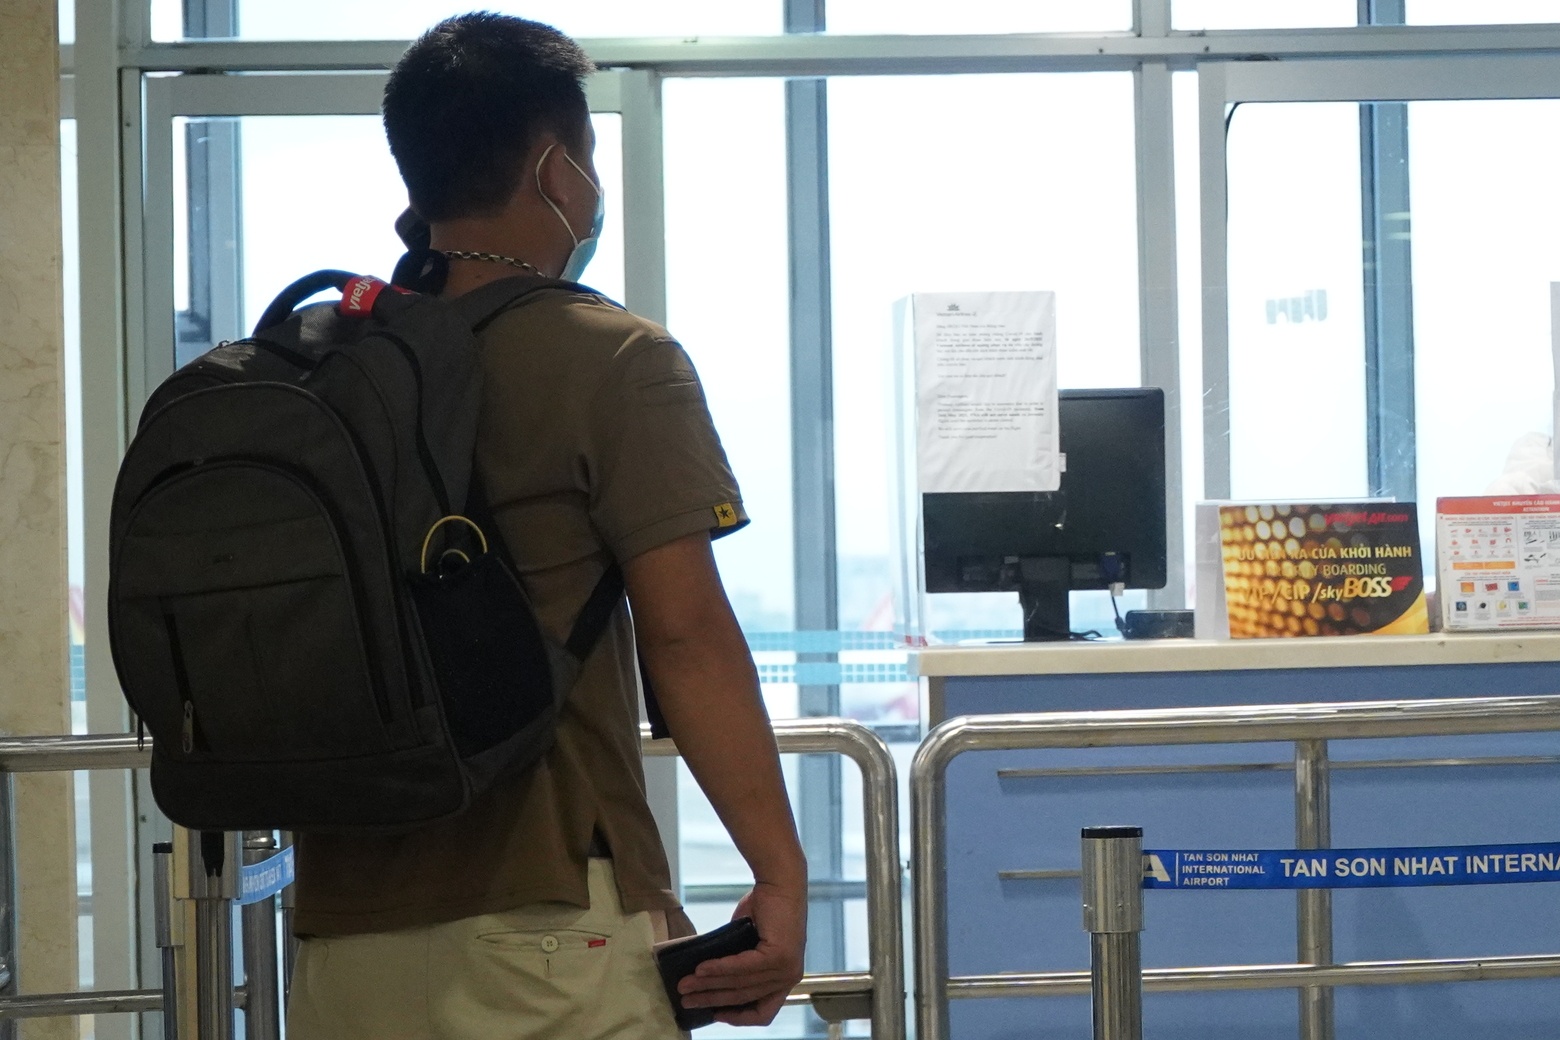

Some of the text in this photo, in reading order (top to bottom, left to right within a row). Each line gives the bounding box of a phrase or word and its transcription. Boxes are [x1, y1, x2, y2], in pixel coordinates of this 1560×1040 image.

[1375, 544, 1413, 558] HÀNH
[1323, 562, 1387, 576] BOARDING
[1183, 853, 1259, 862] TAN SON NHAT
[1182, 865, 1266, 874] INTERNATIONAL
[1279, 858, 1327, 878] TAN
[1334, 857, 1386, 877] SON
[1393, 856, 1459, 876] NHAT
[1183, 877, 1230, 886] AIRPORT
